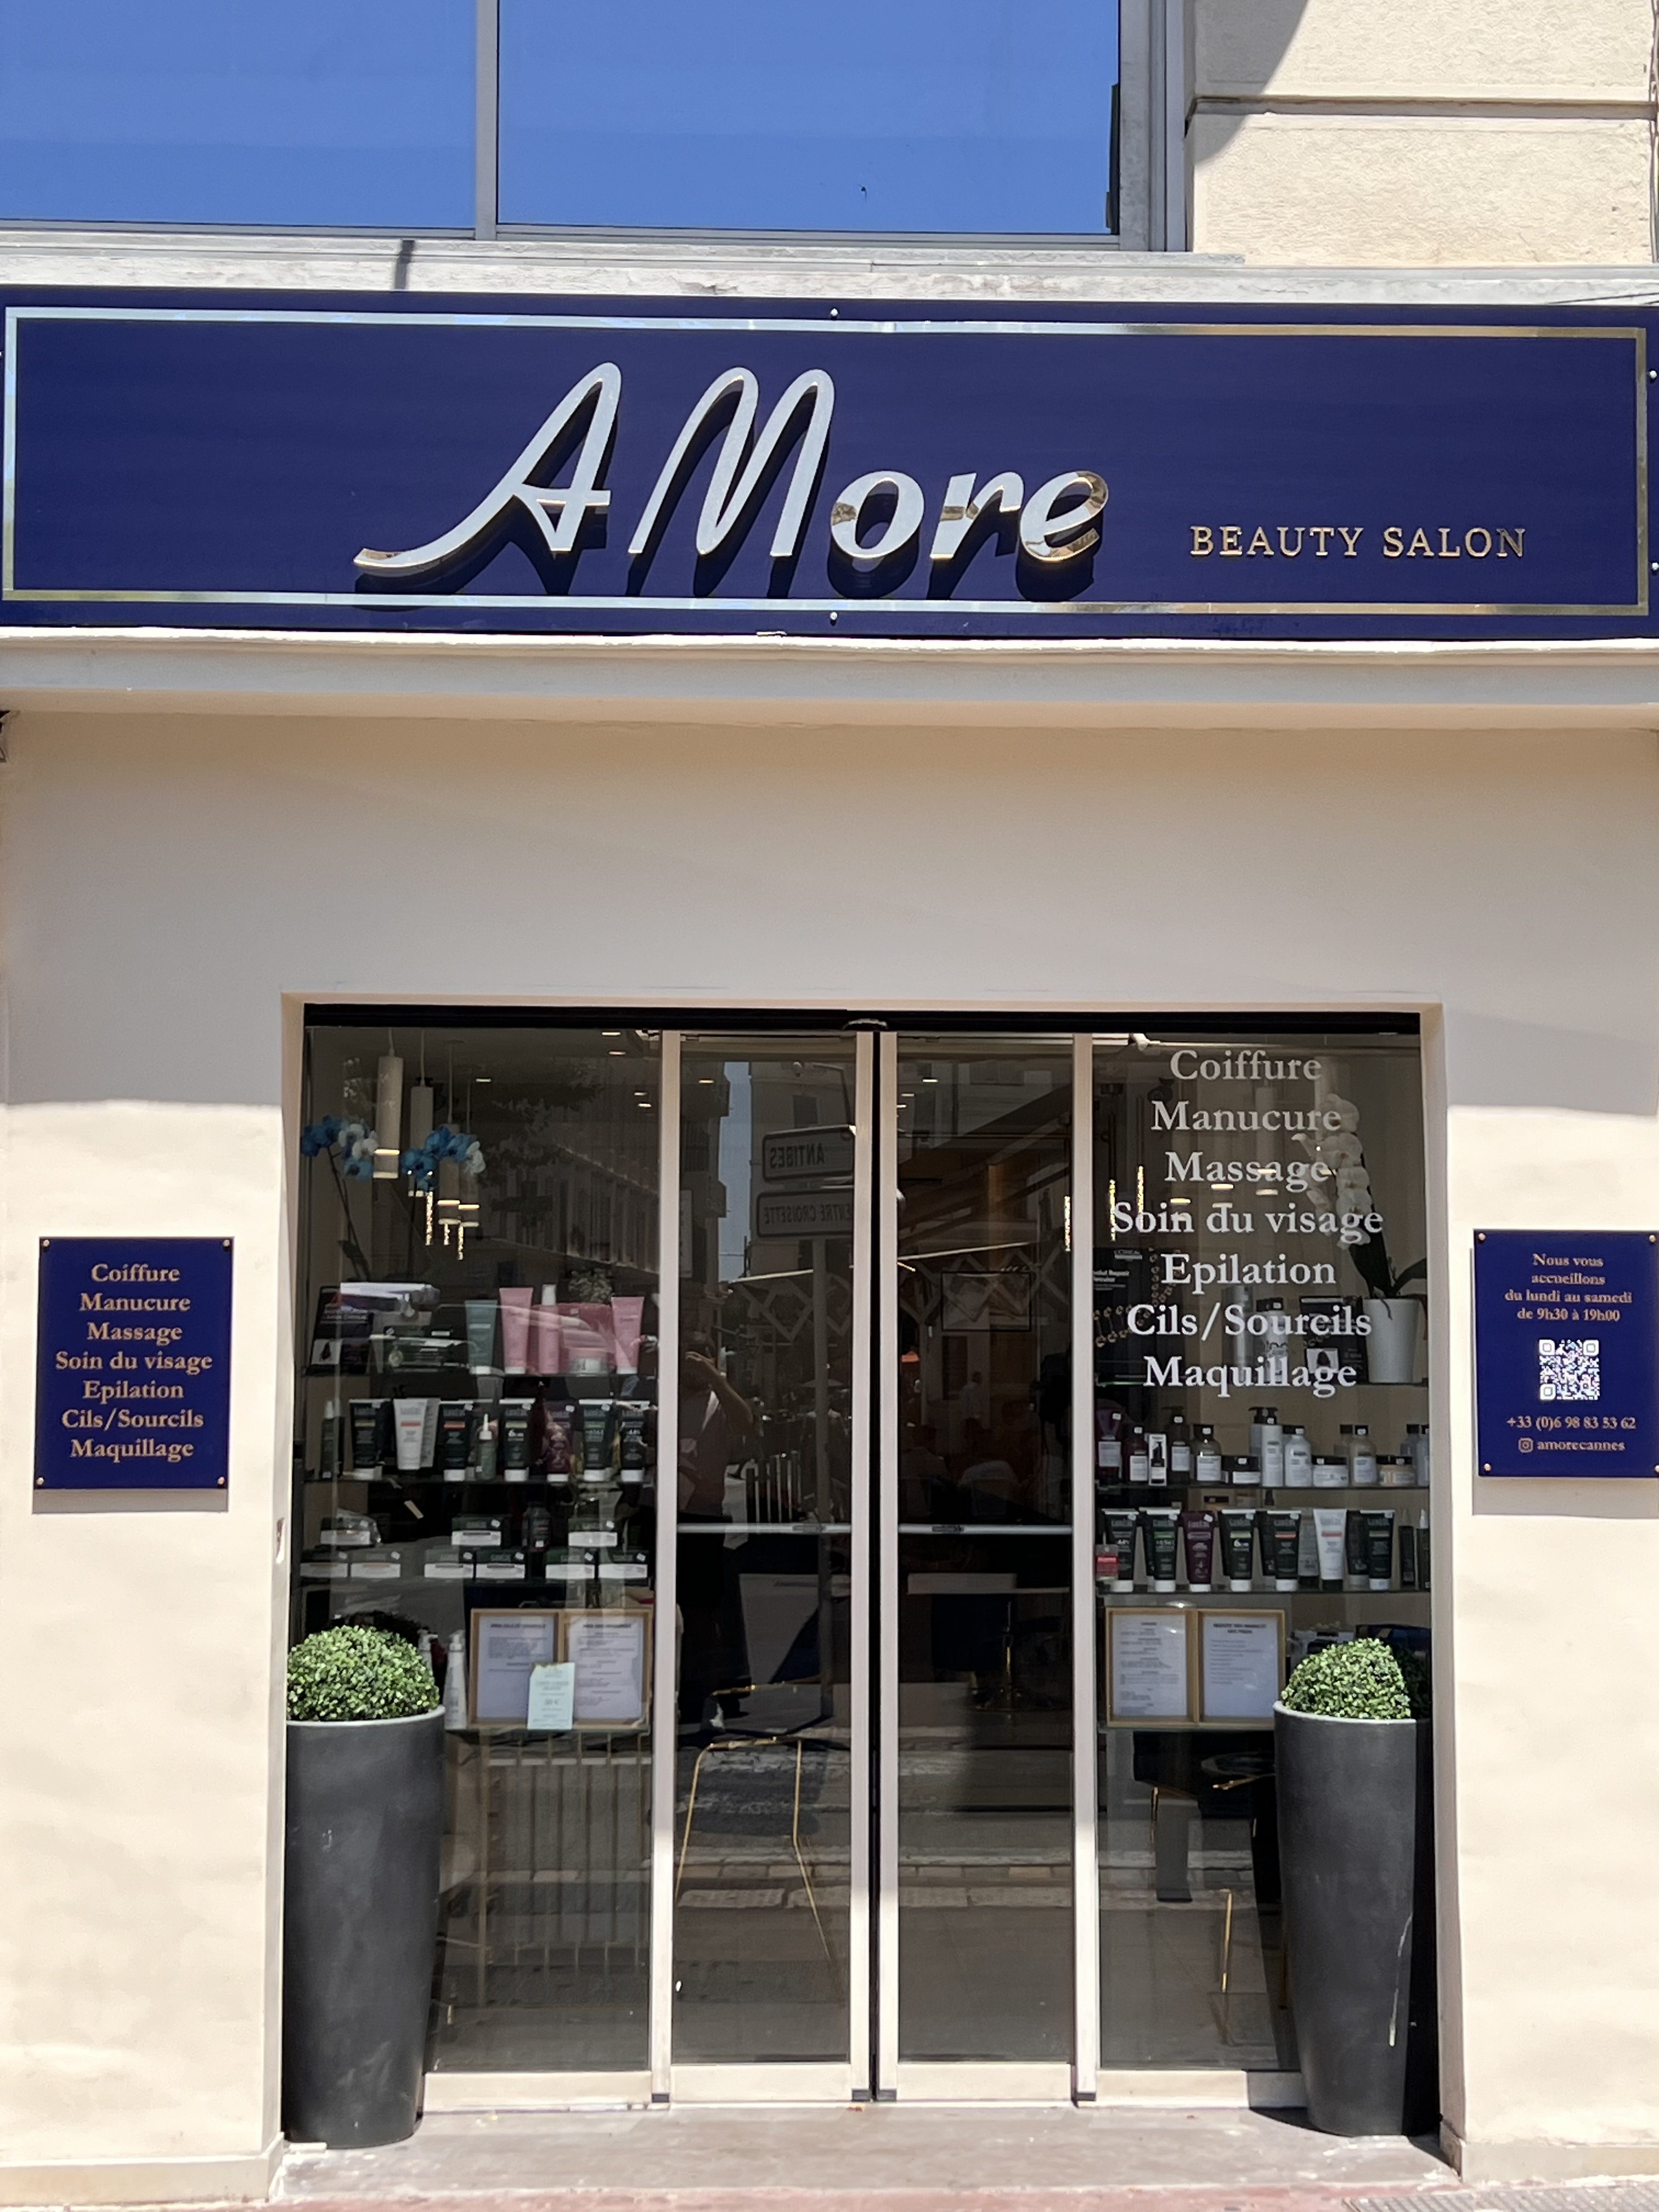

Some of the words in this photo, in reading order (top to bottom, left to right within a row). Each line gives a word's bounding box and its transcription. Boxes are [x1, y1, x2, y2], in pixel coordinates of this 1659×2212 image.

[1190, 527, 1363, 556] BEAUTY
[1384, 527, 1525, 556] SALON
[1170, 1050, 1322, 1080] Coiffure
[1151, 1101, 1342, 1130] Manucure
[1164, 1152, 1330, 1192] Massage
[1111, 1202, 1194, 1233] Soin
[1206, 1203, 1254, 1233] du
[1265, 1203, 1384, 1243] visage
[92, 1263, 180, 1282] Coiffure
[1533, 1254, 1570, 1266] Nous
[1573, 1258, 1604, 1267] vous
[1161, 1254, 1335, 1294] Epilation
[1531, 1272, 1605, 1285] accueillons
[80, 1293, 190, 1311] Manucure
[1505, 1289, 1522, 1301] du
[1526, 1289, 1560, 1302] lundi
[1564, 1294, 1581, 1302] au
[1584, 1291, 1632, 1303] samedi
[1127, 1302, 1372, 1341] Cils/Sourcils
[1517, 1307, 1533, 1319] de
[1537, 1307, 1568, 1320] 9h30
[1572, 1309, 1579, 1321] à
[1583, 1308, 1620, 1322] 19h00
[87, 1322, 183, 1346] Massage
[55, 1351, 103, 1369] Soin
[109, 1351, 137, 1369] du
[144, 1351, 212, 1375] visage
[1143, 1356, 1357, 1397] Maquillage
[83, 1380, 184, 1404] Epilation
[62, 1408, 204, 1430] Cils/Sourcils
[1506, 1415, 1532, 1428] +33
[1536, 1416, 1562, 1431] (0)6
[1565, 1416, 1581, 1429] 98
[1583, 1417, 1599, 1429] 83
[1621, 1417, 1636, 1429] 62
[71, 1438, 194, 1463] Maquillage
[1537, 1441, 1626, 1451] amorecannes
